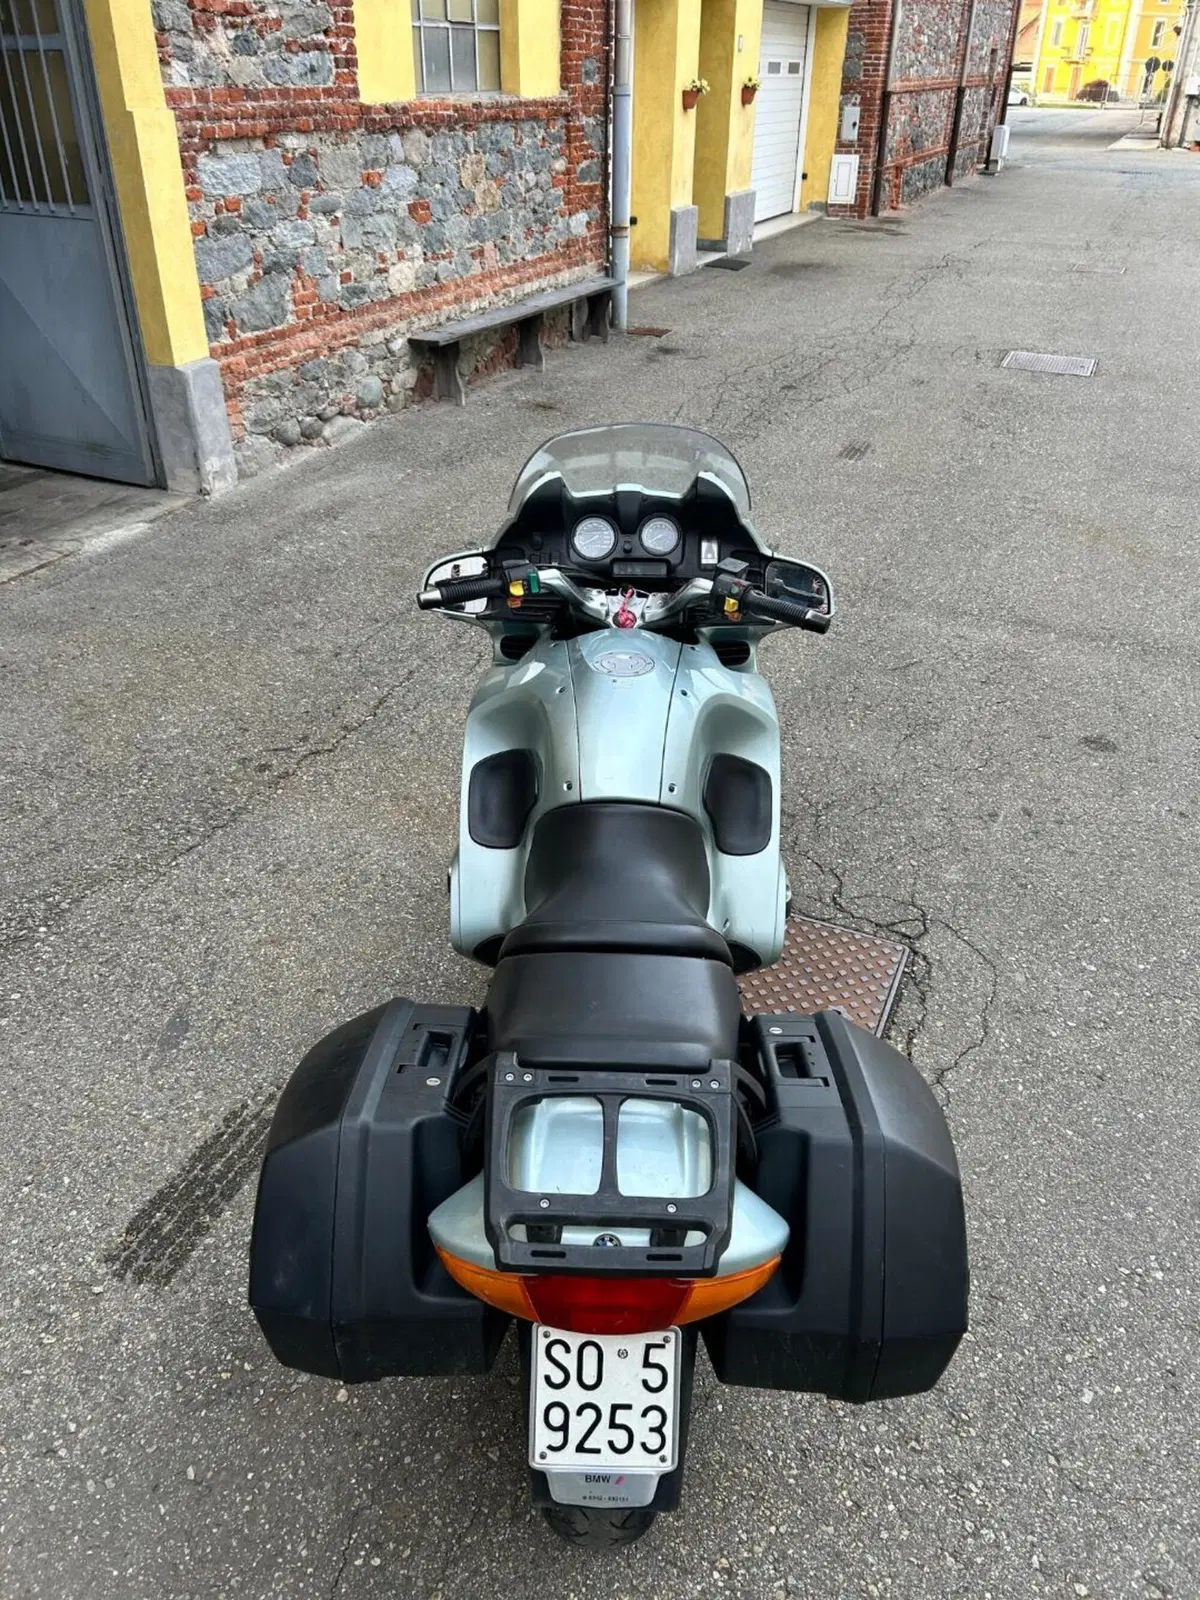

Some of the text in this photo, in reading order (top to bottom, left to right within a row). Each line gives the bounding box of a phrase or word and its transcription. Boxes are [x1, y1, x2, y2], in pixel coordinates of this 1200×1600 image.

[544, 1338, 669, 1394] SO 5
[543, 1401, 668, 1455] 9253
[584, 1474, 611, 1484] BMW
